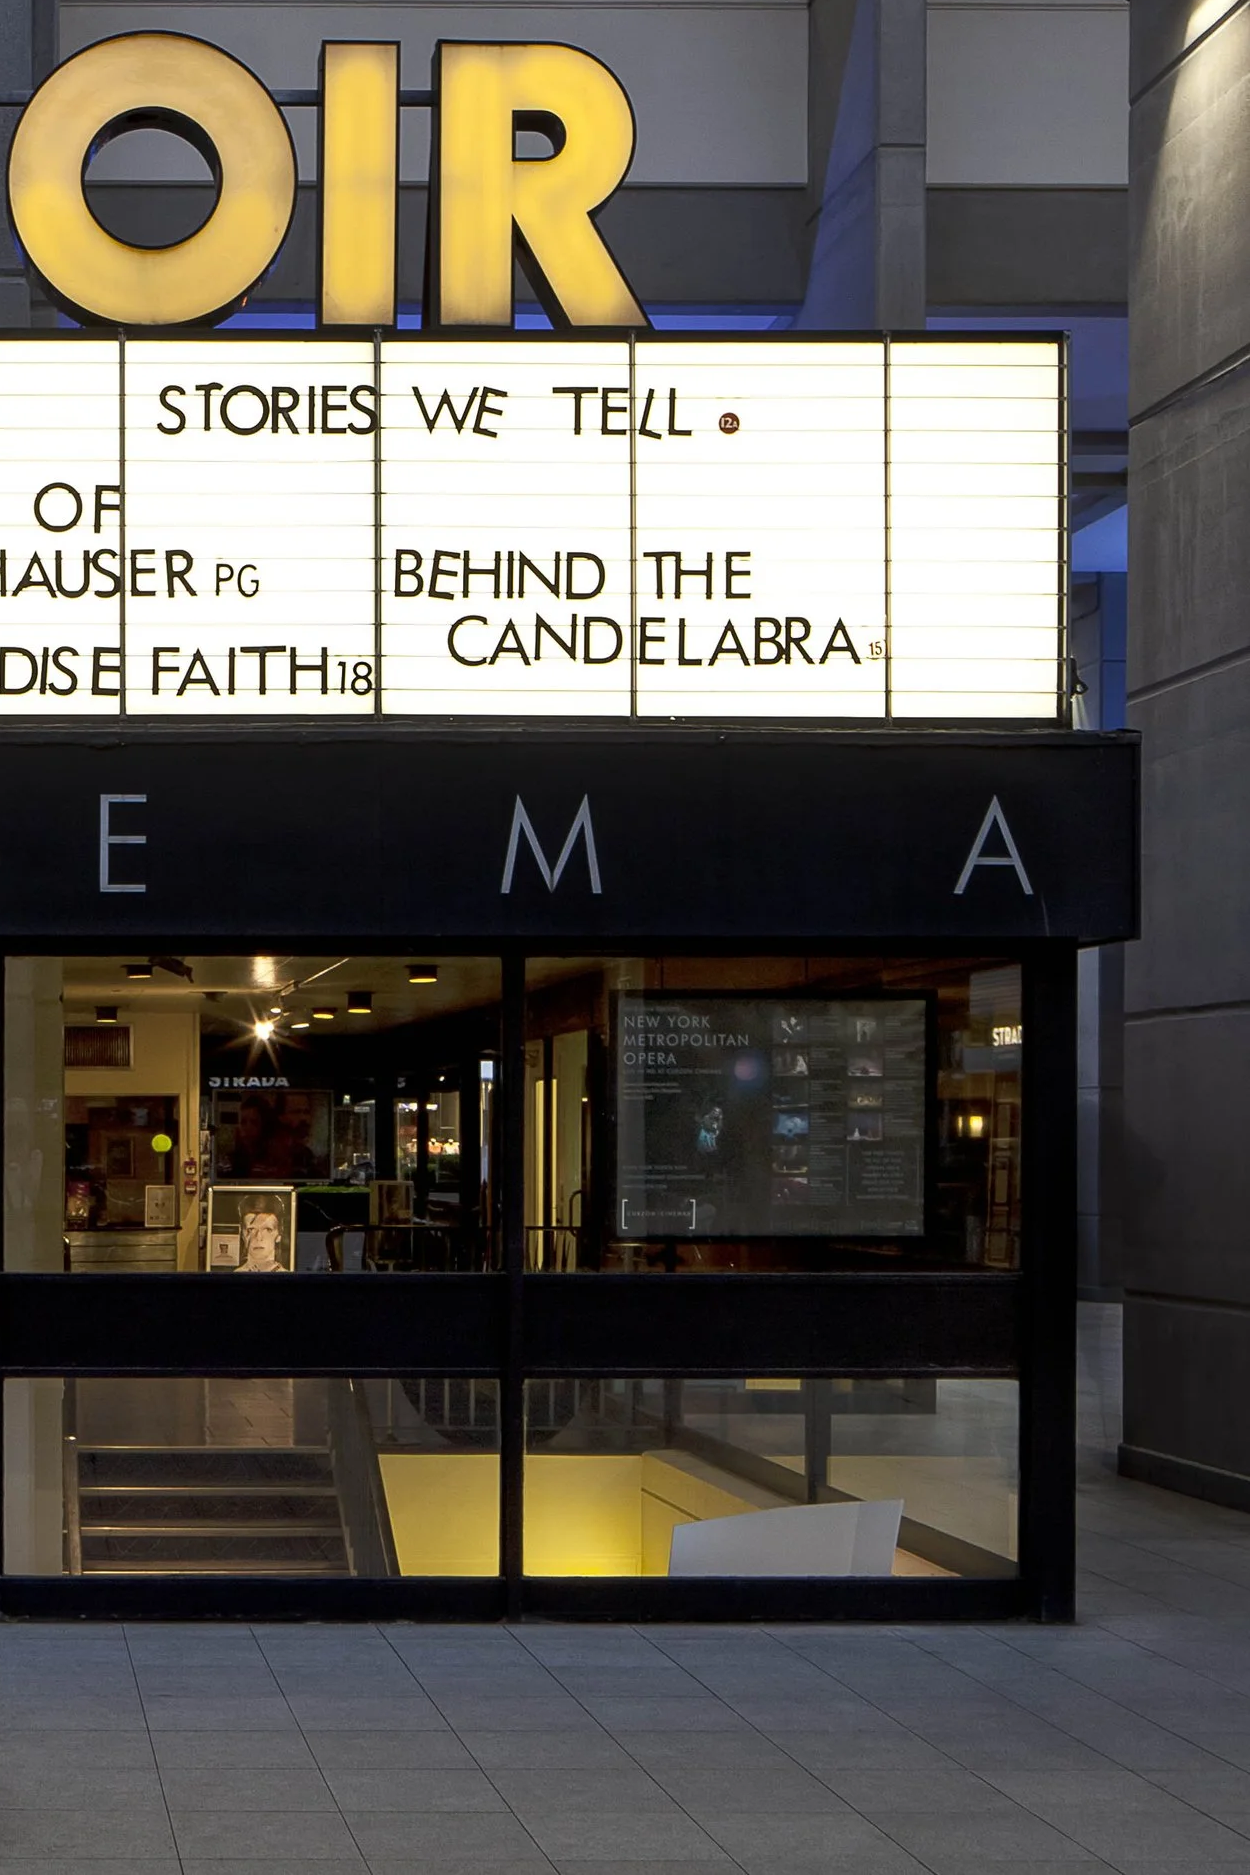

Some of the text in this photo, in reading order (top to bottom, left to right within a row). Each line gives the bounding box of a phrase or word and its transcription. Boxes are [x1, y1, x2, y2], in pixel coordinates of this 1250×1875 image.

[156, 382, 378, 436] STORIES
[412, 385, 508, 438] WE
[552, 386, 692, 440] TELL
[33, 481, 121, 534] OF
[215, 562, 261, 598] PG
[393, 547, 752, 602] BEHIND THE
[447, 612, 862, 667] CANDELABRA
[150, 644, 330, 698] FAITH
[336, 660, 374, 696] 18
[623, 1015, 711, 1029] NEW YORK
[623, 1033, 750, 1047] METROPOLITAN
[623, 1052, 677, 1066] OPERA
